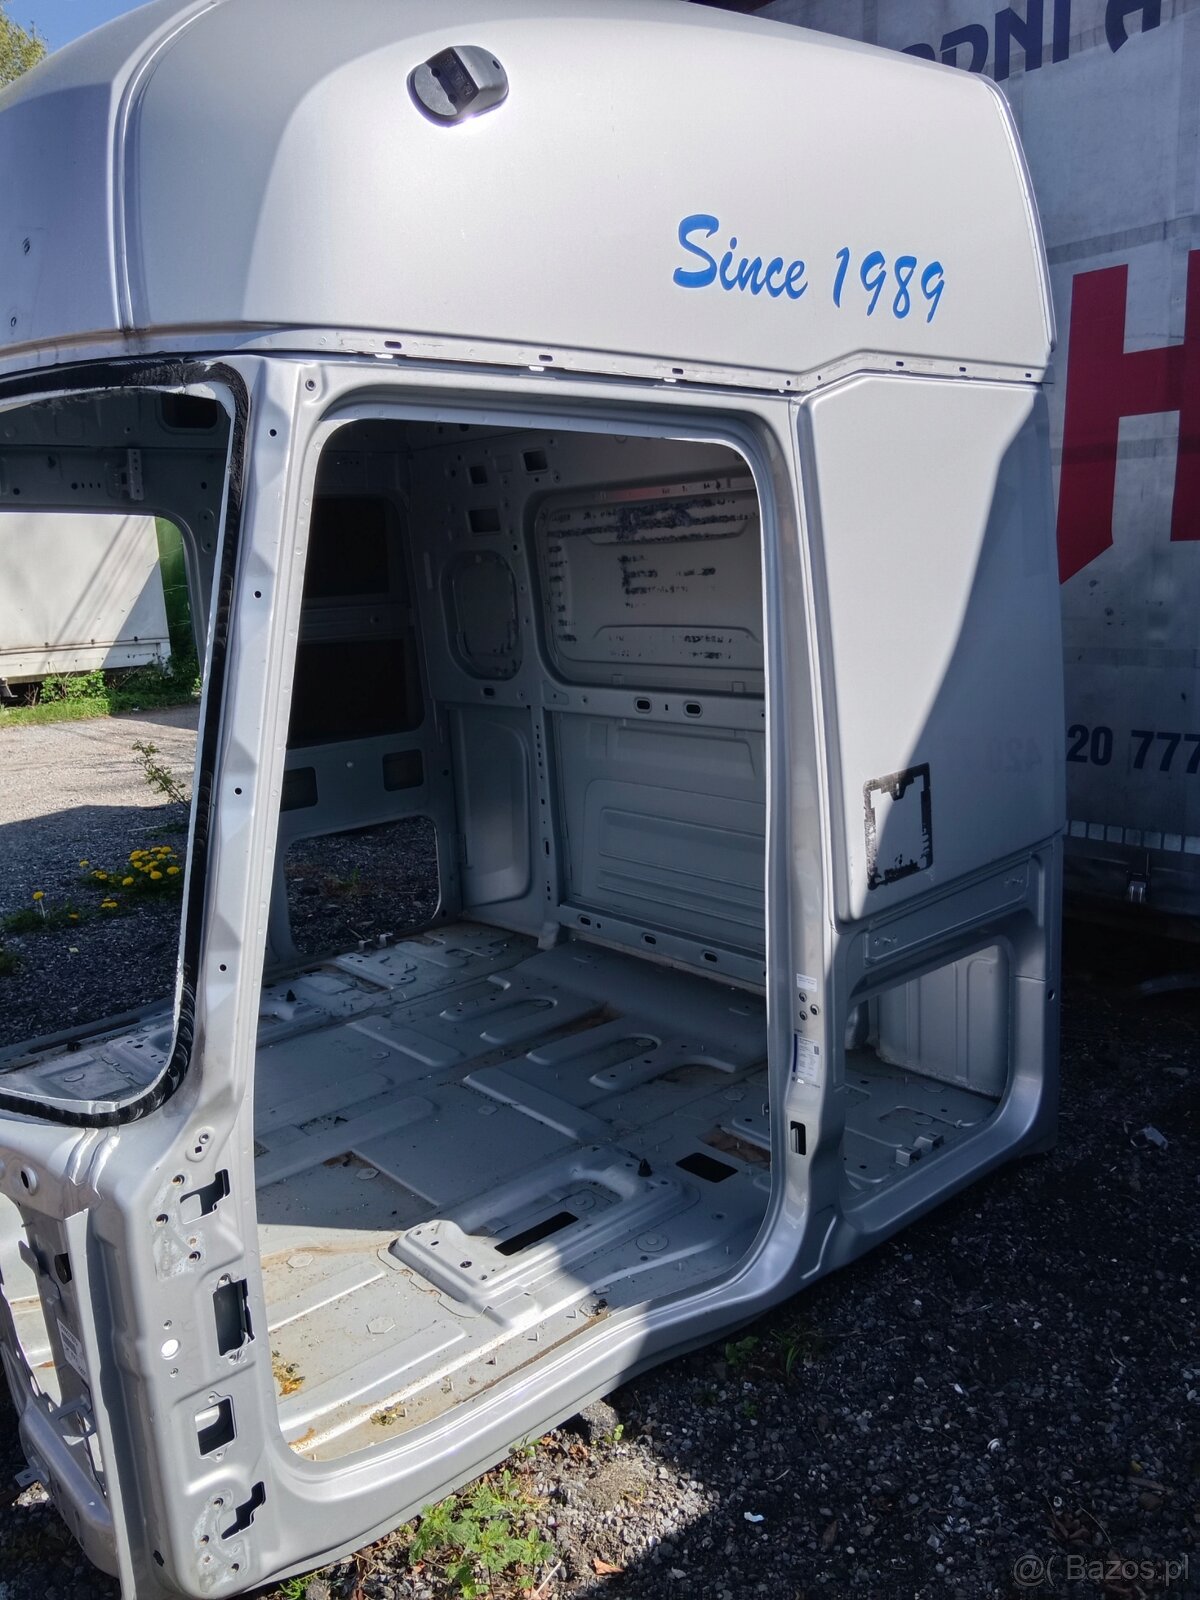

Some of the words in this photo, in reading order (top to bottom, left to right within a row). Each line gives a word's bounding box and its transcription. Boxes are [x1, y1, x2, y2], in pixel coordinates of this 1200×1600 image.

[673, 214, 808, 300] Since
[833, 246, 946, 323] 1989
[1131, 729, 1200, 774] 777
